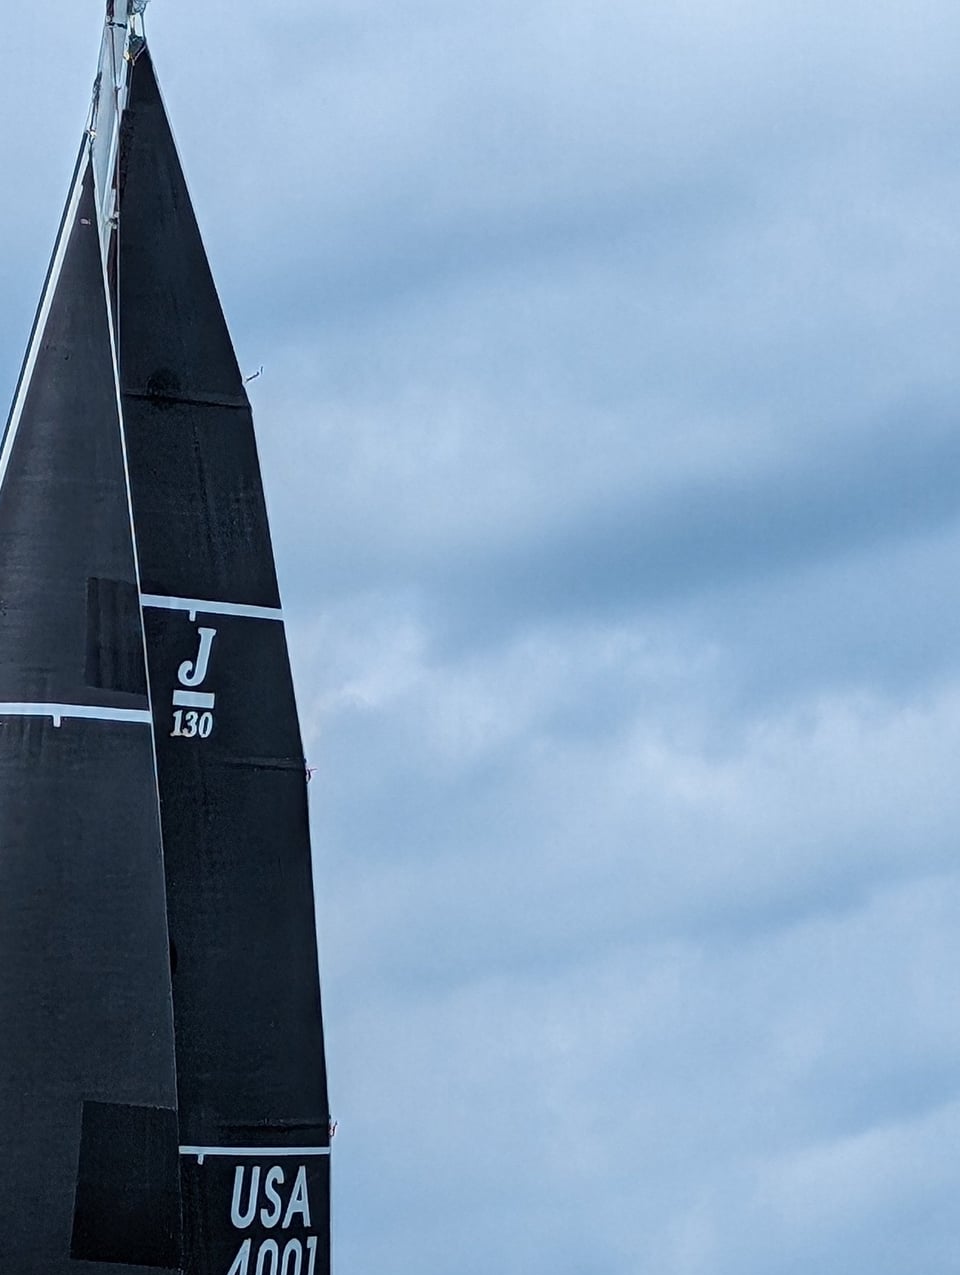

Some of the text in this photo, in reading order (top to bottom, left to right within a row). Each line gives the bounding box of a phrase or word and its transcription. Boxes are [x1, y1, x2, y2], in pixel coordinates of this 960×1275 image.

[178, 628, 216, 686] J
[171, 710, 212, 738] 130
[231, 1166, 311, 1228] USA
